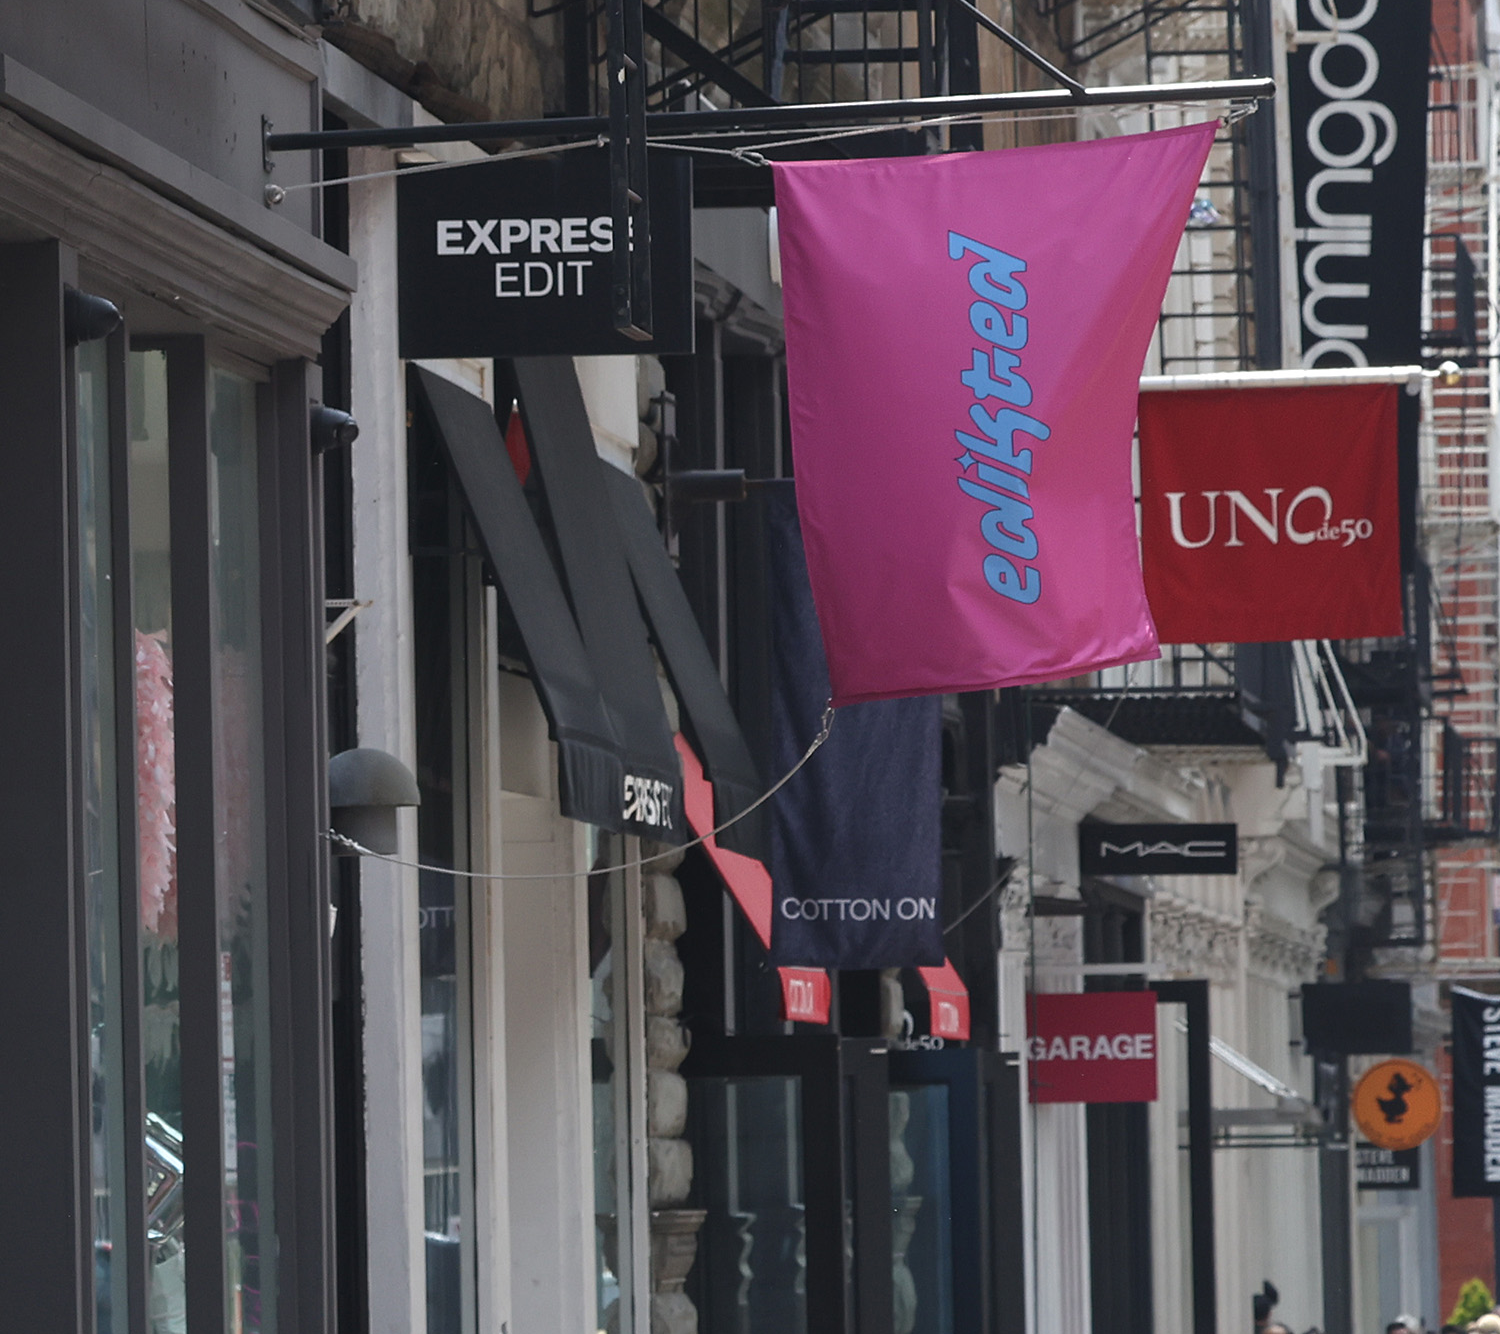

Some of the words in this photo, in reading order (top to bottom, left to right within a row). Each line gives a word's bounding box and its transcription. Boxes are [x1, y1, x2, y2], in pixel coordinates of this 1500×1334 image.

[437, 216, 634, 255] EXPRES
[495, 261, 593, 298] EDIT
[948, 230, 1051, 605] edikted
[1102, 840, 1226, 858] MAC
[781, 897, 890, 921] COTTON
[896, 897, 936, 920] ON
[1029, 1033, 1154, 1060] GARAGE
